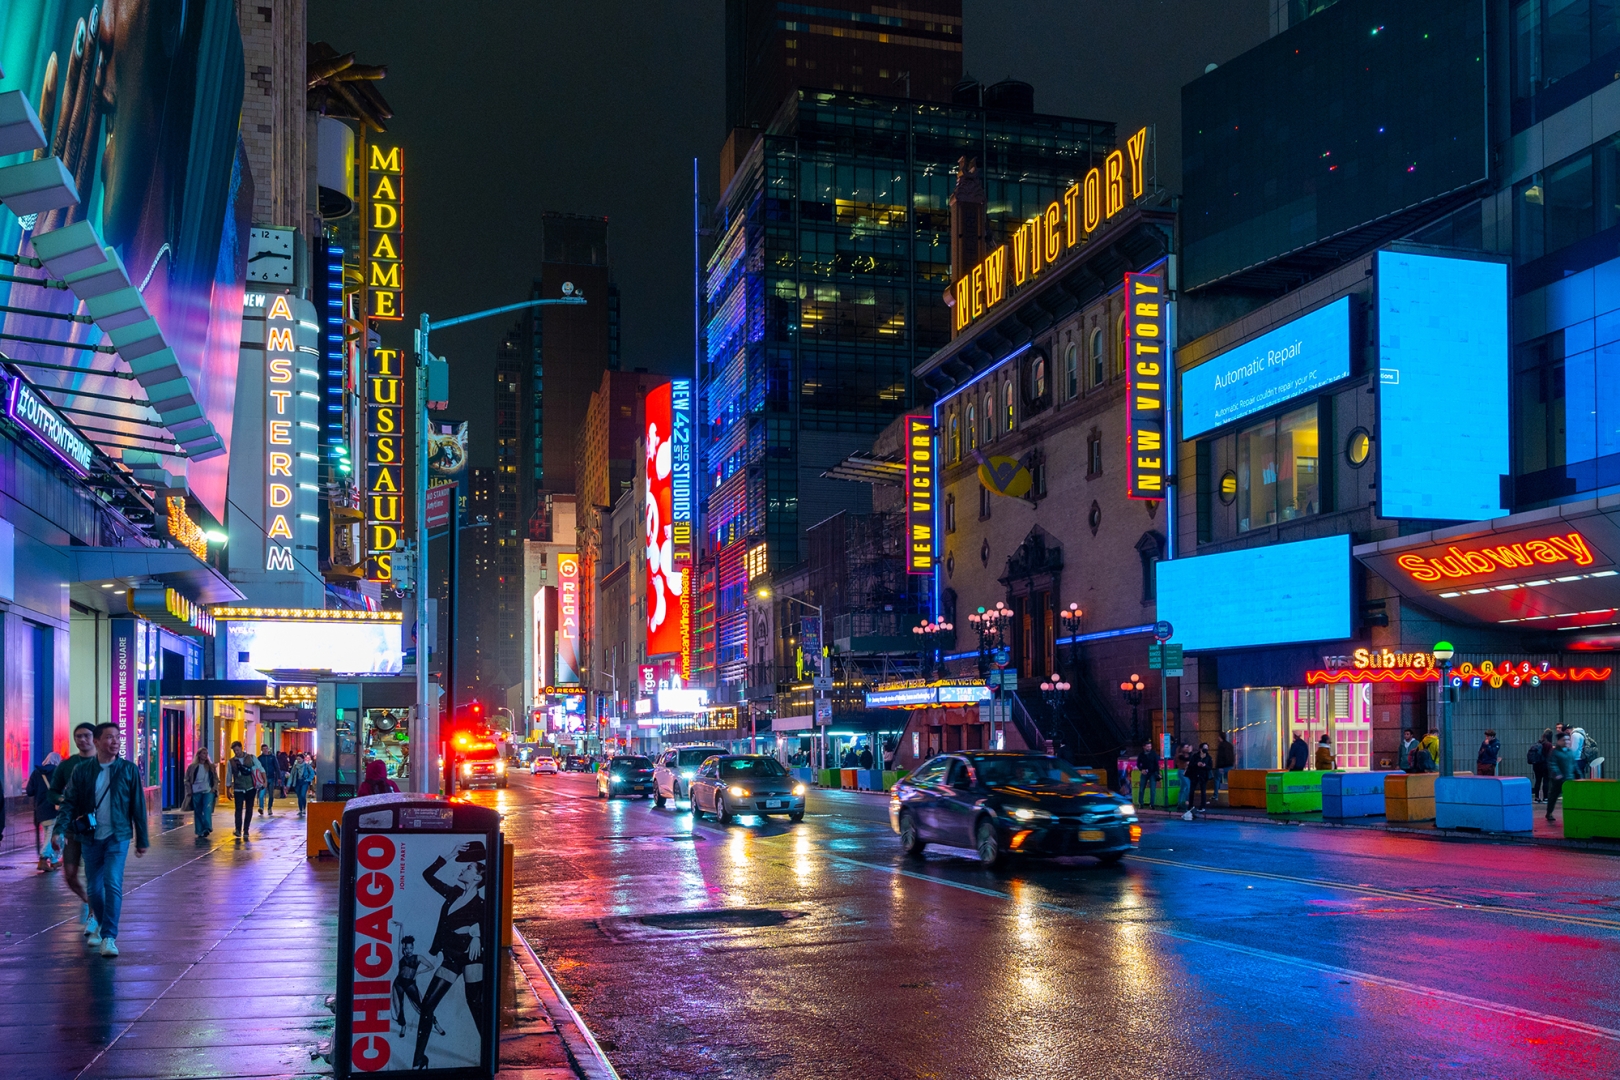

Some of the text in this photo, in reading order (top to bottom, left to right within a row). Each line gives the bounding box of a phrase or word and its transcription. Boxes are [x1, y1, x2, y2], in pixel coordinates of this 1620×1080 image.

[957, 126, 1147, 331] NEW VICTORY
[262, 272, 268, 280] 6
[244, 294, 266, 307] NEW
[371, 145, 400, 579] MADAME TUSSAUD'S
[1135, 281, 1161, 491] NEW VICTORY
[1214, 339, 1303, 390] Automatic Repair
[672, 380, 690, 410] NEW
[1214, 370, 1318, 418] Automatic Repair couldn't repair your PC
[17, 385, 92, 471] #OUTFRONTPRIME
[267, 295, 294, 571] AMSTERDAM
[673, 463, 691, 520] STUDIOS
[913, 421, 931, 569] NEW VICTORY
[1398, 531, 1595, 582] Subway
[563, 582, 575, 638] REGAL
[119, 637, 127, 670] SQUARE
[1354, 648, 1436, 671] Subway
[1463, 662, 1548, 674] Q R 1 3 7
[119, 671, 127, 696] TIMES
[958, 678, 986, 686] VICTORY
[1453, 676, 1538, 686] C E W 2 S
[119, 697, 127, 728] BETTER
[818, 709, 830, 717] 25
[352, 834, 396, 1073] CHICAGO
